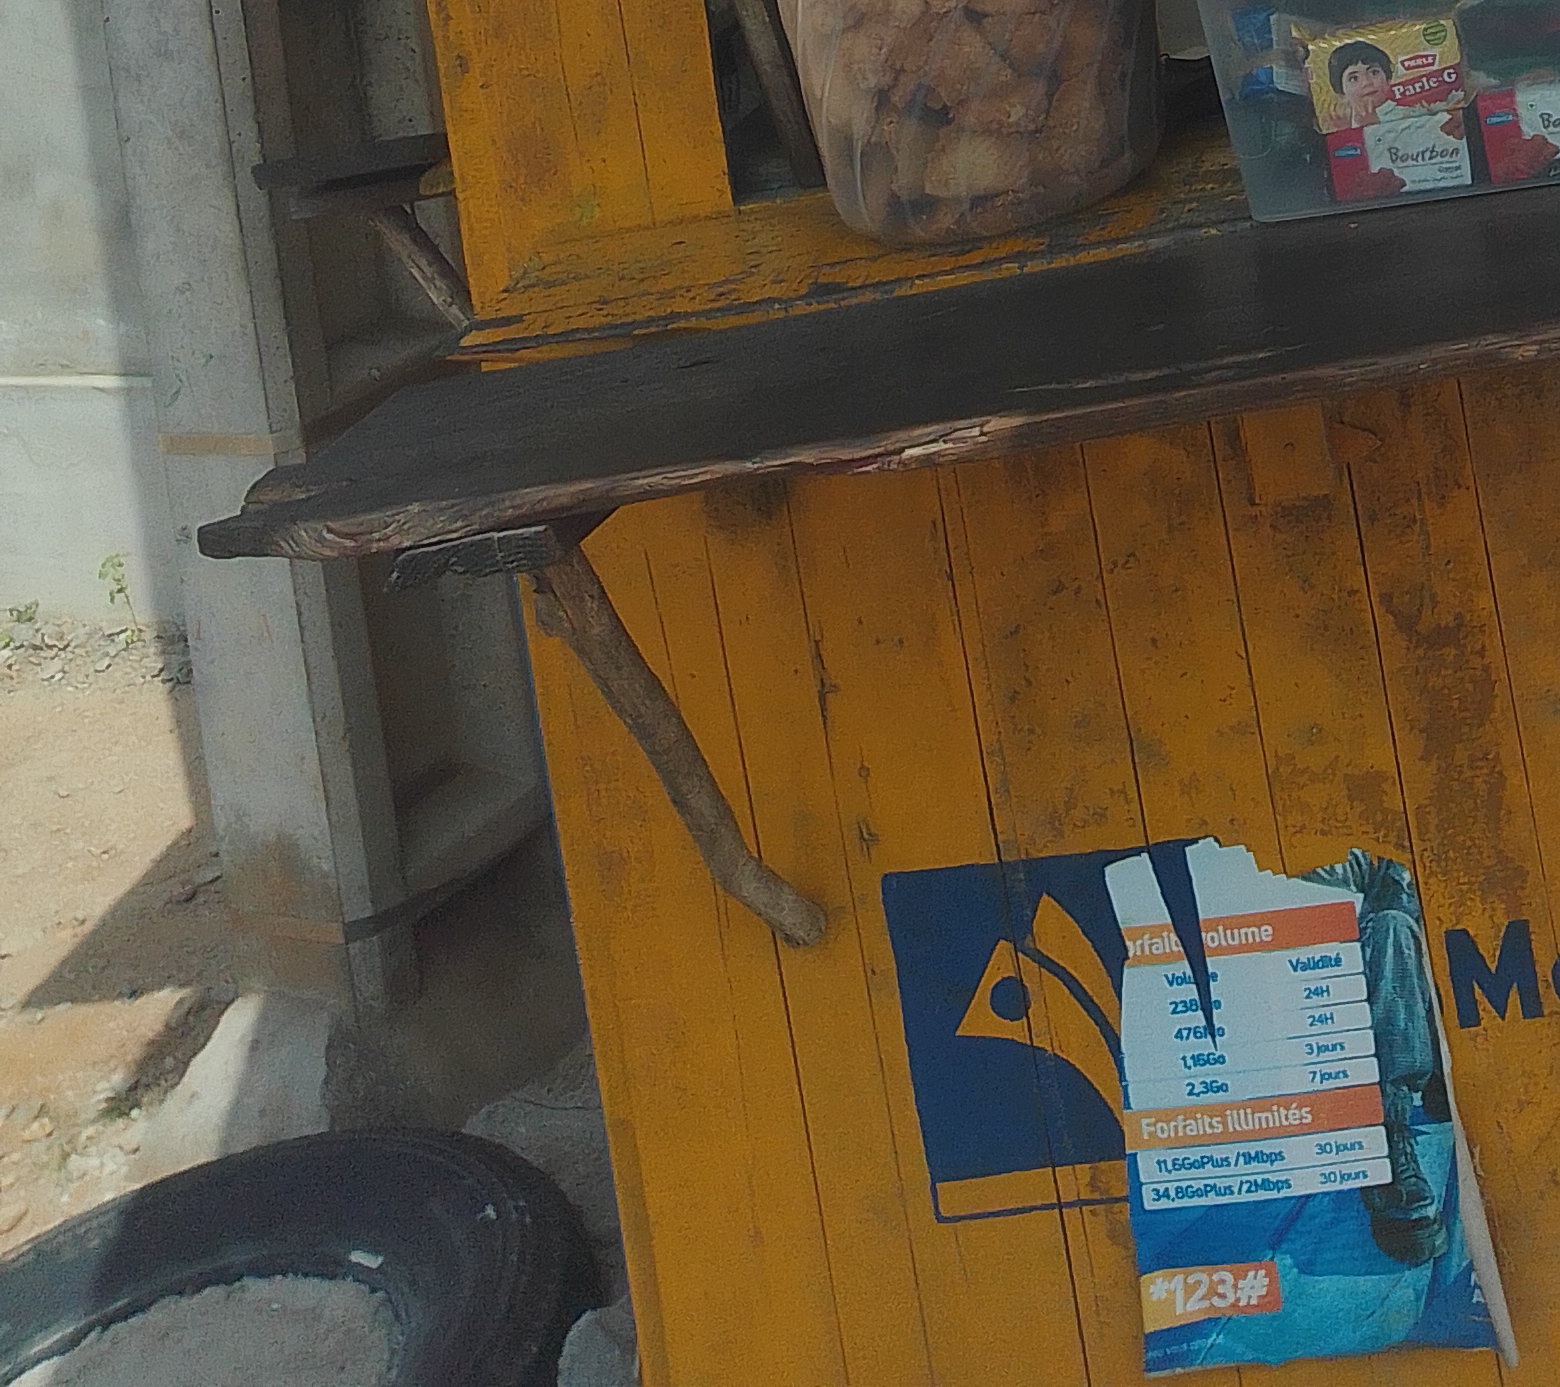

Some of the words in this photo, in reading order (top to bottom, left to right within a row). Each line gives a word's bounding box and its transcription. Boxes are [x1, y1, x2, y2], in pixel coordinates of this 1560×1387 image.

[1392, 66, 1458, 101] Parle-G
[1388, 142, 1461, 164] Bourbon
[1288, 953, 1343, 974] Validité
[1169, 999, 1222, 1015] 238o
[1304, 986, 1330, 1000] 24H
[1307, 1014, 1334, 1028] 24H
[1305, 1044, 1314, 1055] 3
[1315, 1041, 1345, 1057] jours
[1309, 1071, 1316, 1082] 7
[1317, 1068, 1349, 1085] jours
[1140, 1116, 1221, 1140] Forfaits
[1228, 1104, 1312, 1133] illimités
[1315, 1141, 1333, 1155] 30
[1334, 1139, 1363, 1156] jours
[1320, 1172, 1336, 1185] 30
[1338, 1169, 1369, 1187] jours
